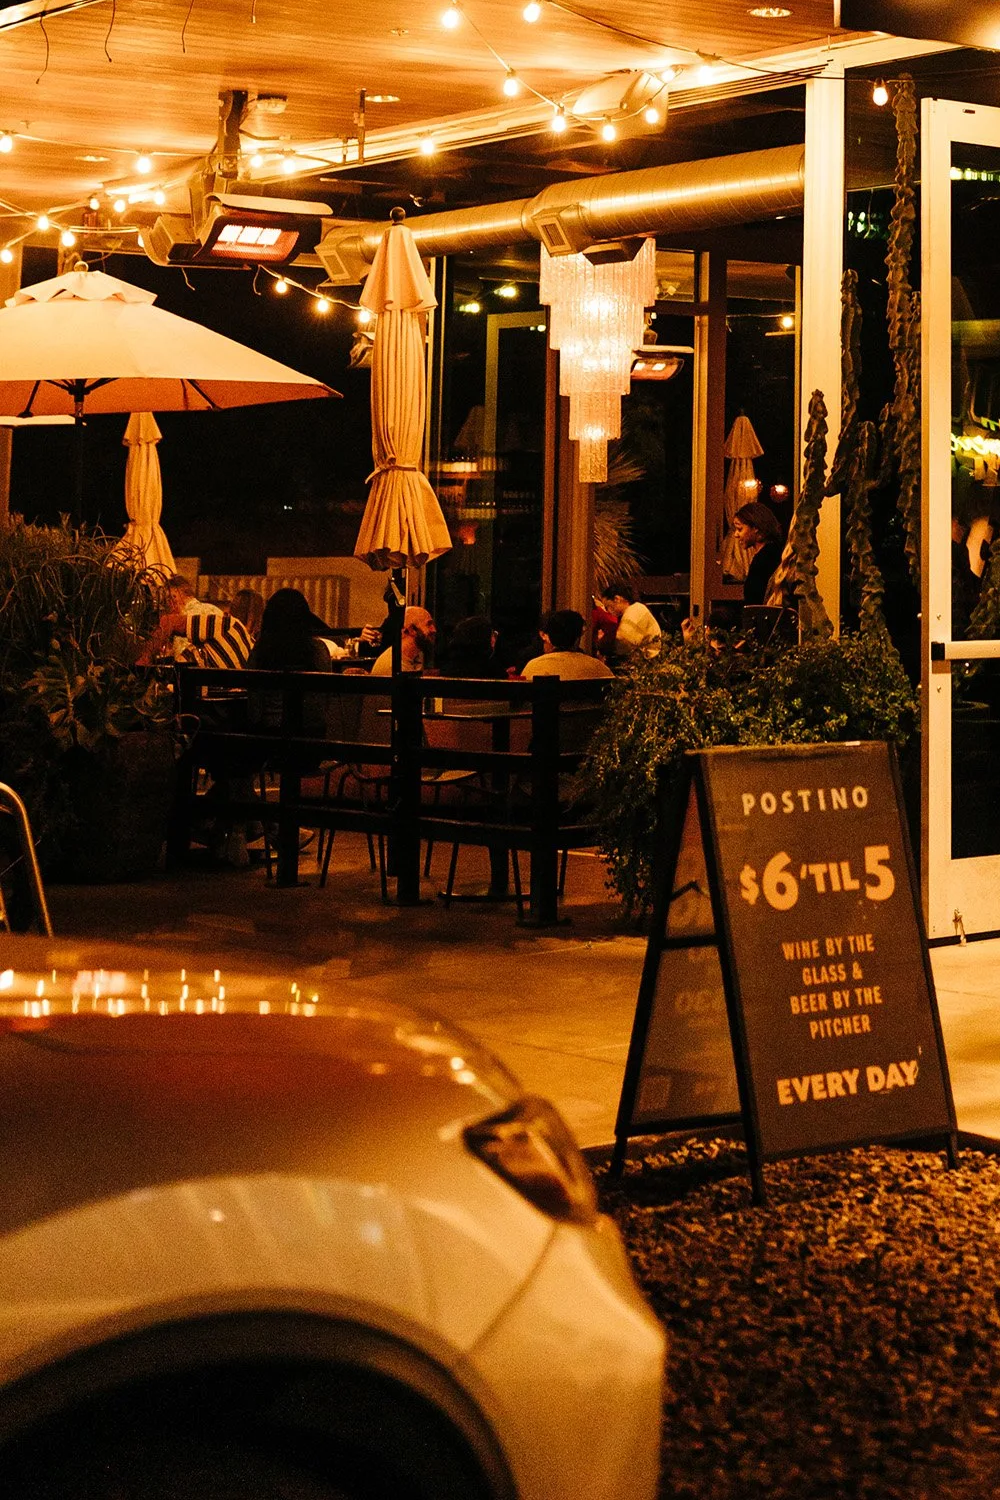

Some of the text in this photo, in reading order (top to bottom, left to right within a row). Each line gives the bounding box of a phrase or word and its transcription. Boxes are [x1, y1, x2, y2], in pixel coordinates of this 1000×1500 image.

[741, 785, 869, 816] POSTINO
[740, 851, 799, 911] $6
[863, 845, 895, 901] 5
[782, 933, 875, 961] WINE BY THE
[802, 960, 863, 985] GLASS &
[789, 985, 882, 1015] BEER BY THE
[809, 1015, 871, 1039] PITCHER
[777, 1059, 918, 1106] EVERY DAY
